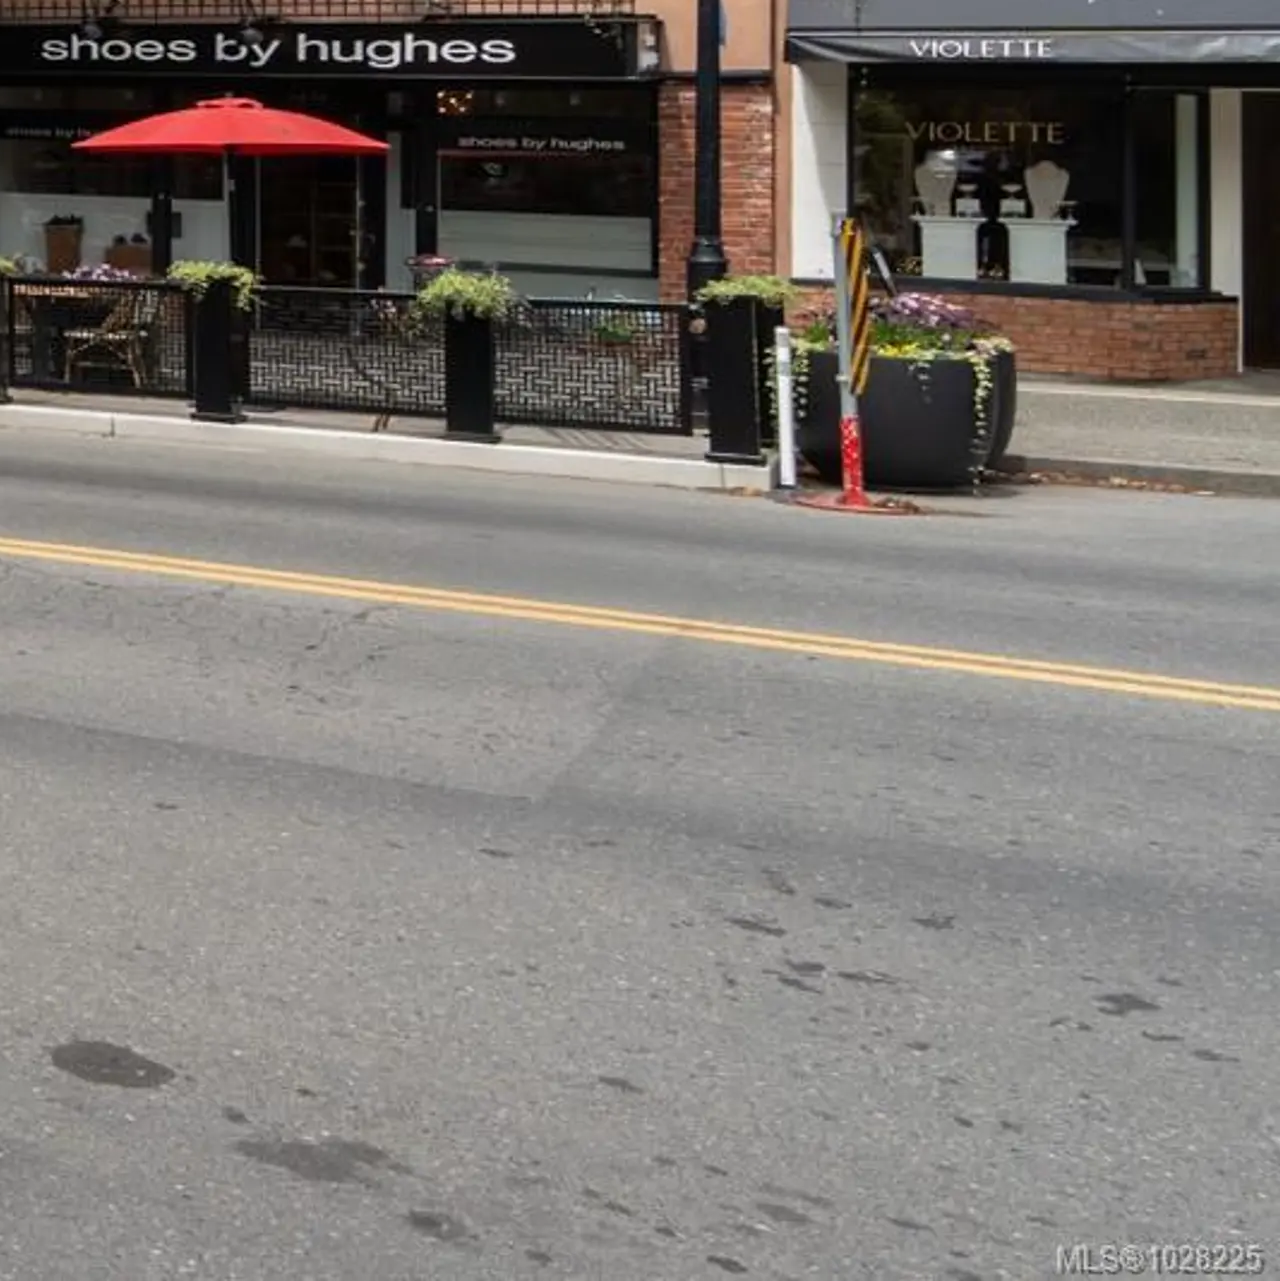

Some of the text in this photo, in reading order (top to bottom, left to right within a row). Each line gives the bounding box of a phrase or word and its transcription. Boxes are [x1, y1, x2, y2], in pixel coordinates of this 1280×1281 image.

[41, 33, 517, 68] shoes by hughes
[909, 39, 1054, 59] VIOLETTE
[550, 137, 625, 151] hughes
[905, 121, 1065, 145] VIOLETTE
